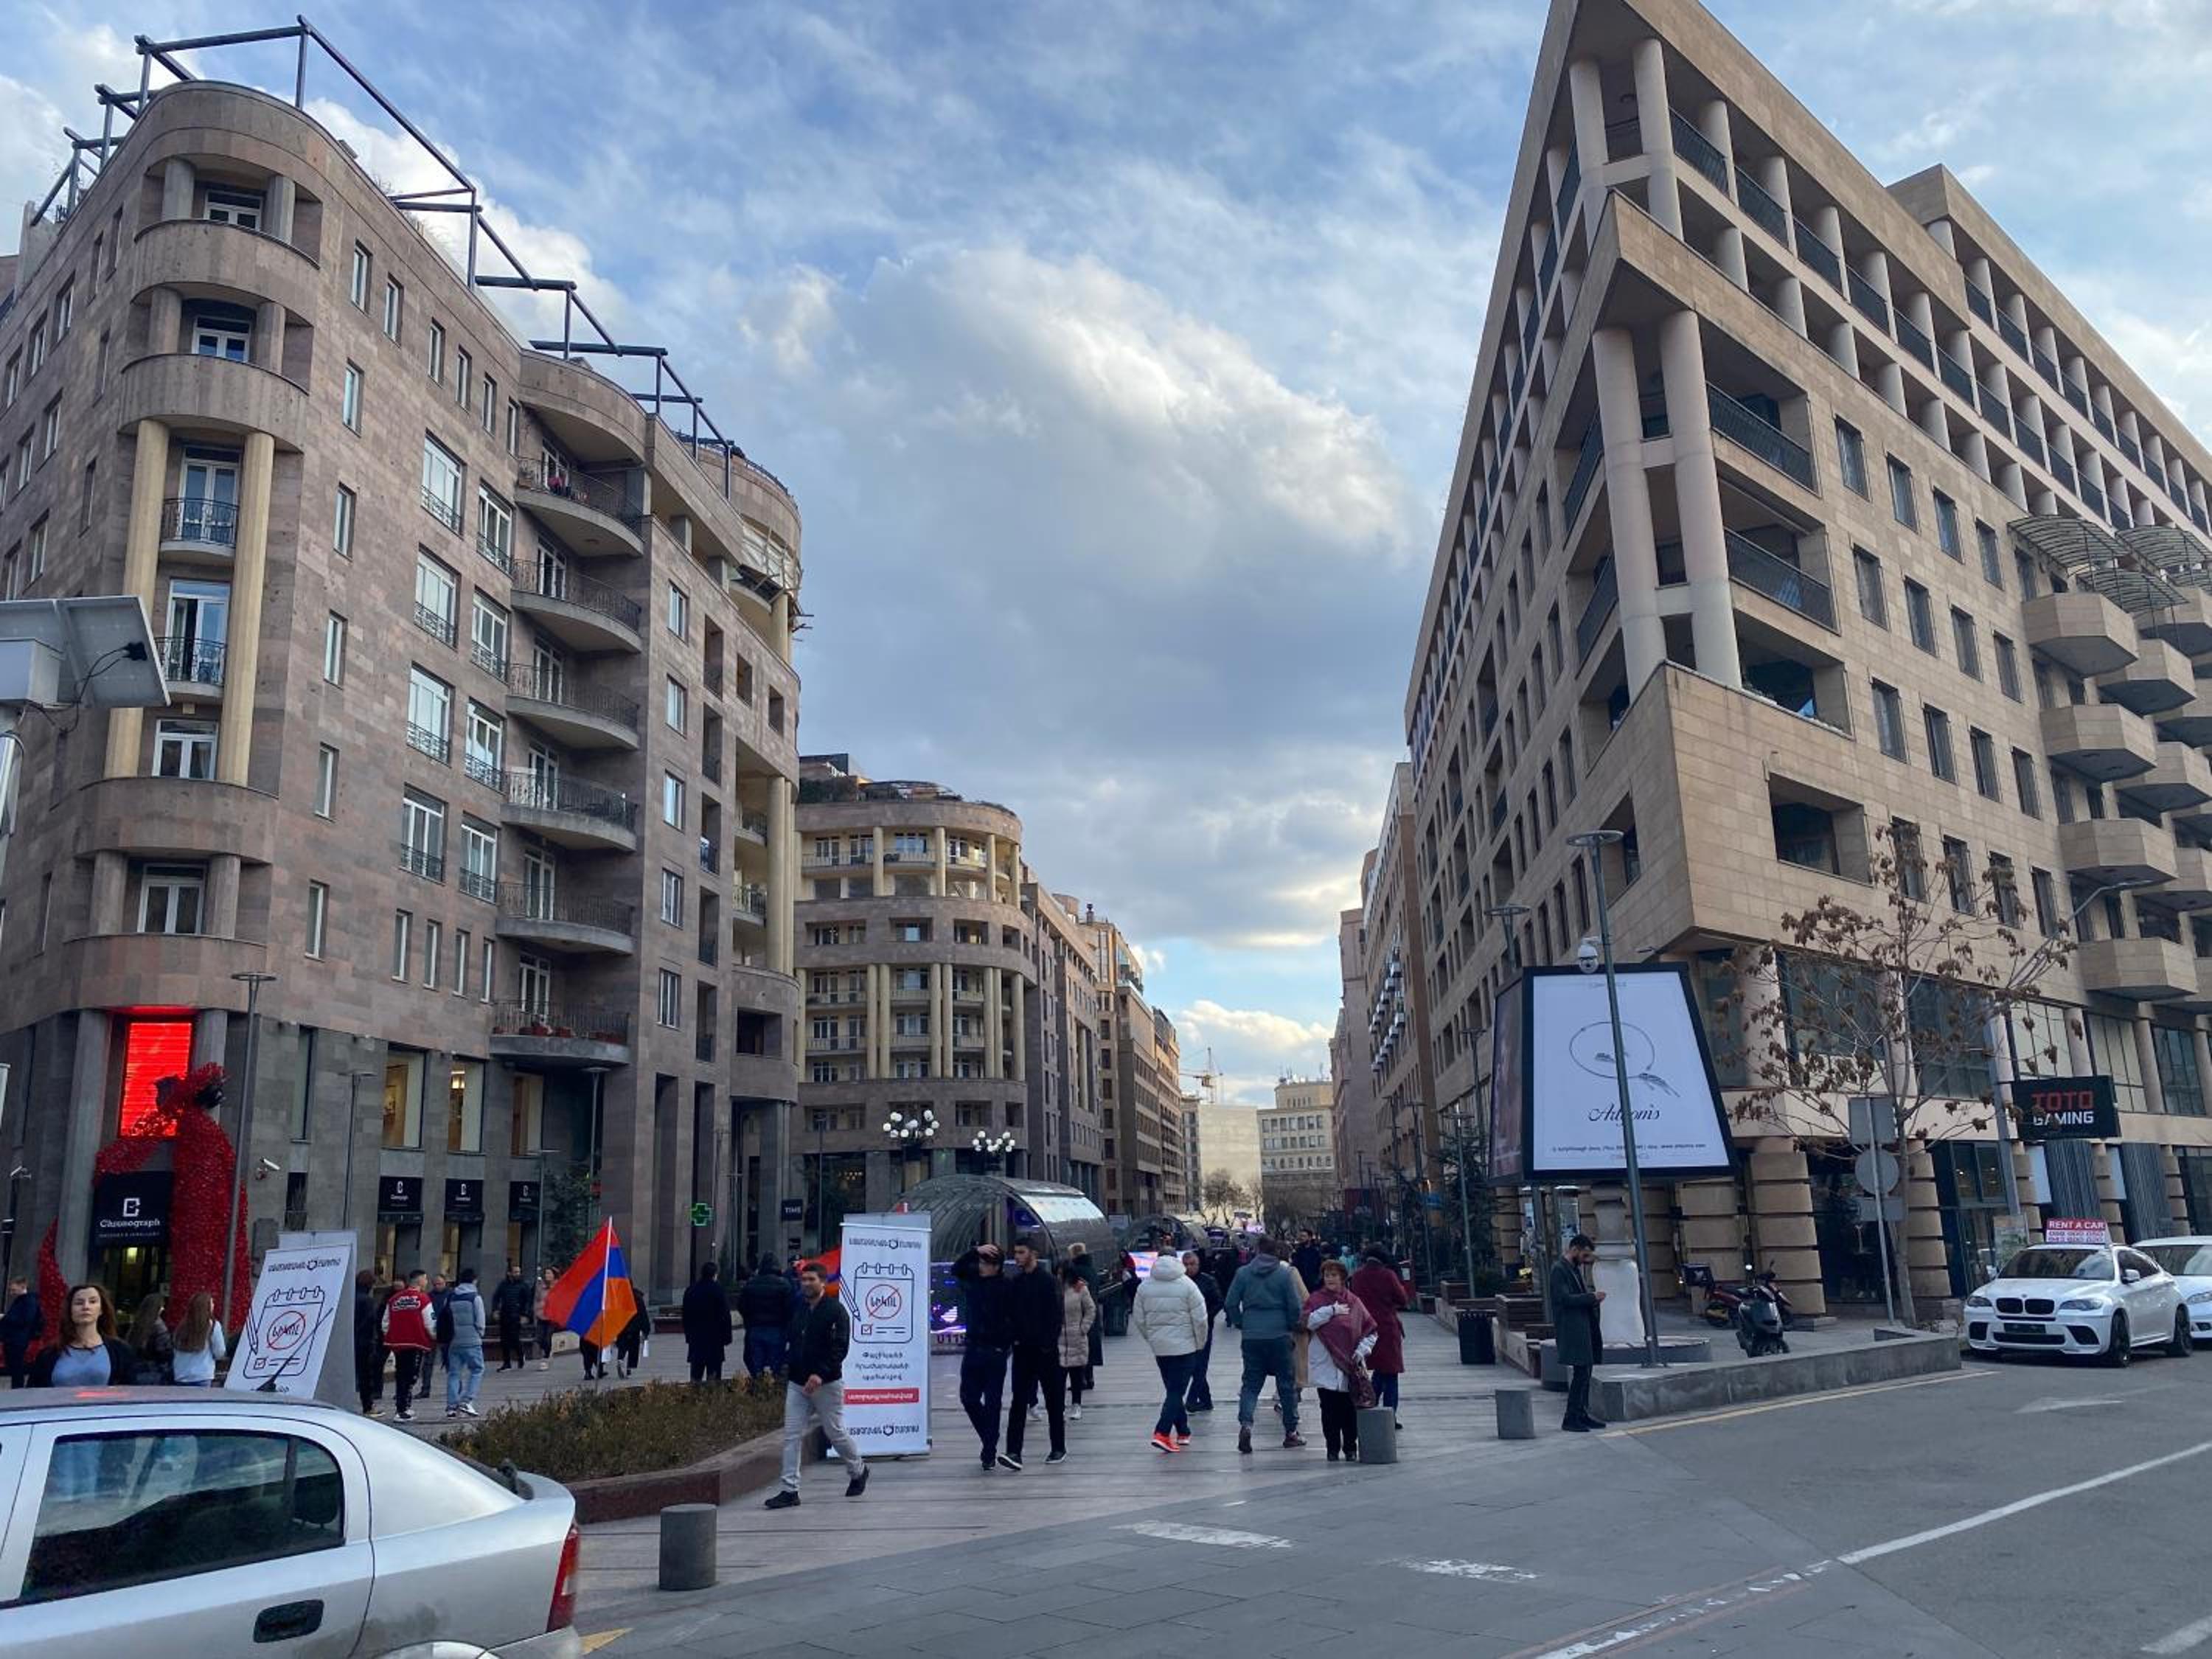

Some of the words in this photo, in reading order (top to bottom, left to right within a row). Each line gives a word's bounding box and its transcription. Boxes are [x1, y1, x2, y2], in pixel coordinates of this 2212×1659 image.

[2031, 1092, 2094, 1110] TOTO
[2049, 1220, 2074, 1229] RENT
[2076, 1221, 2083, 1229] A
[2084, 1221, 2106, 1229] CAR
